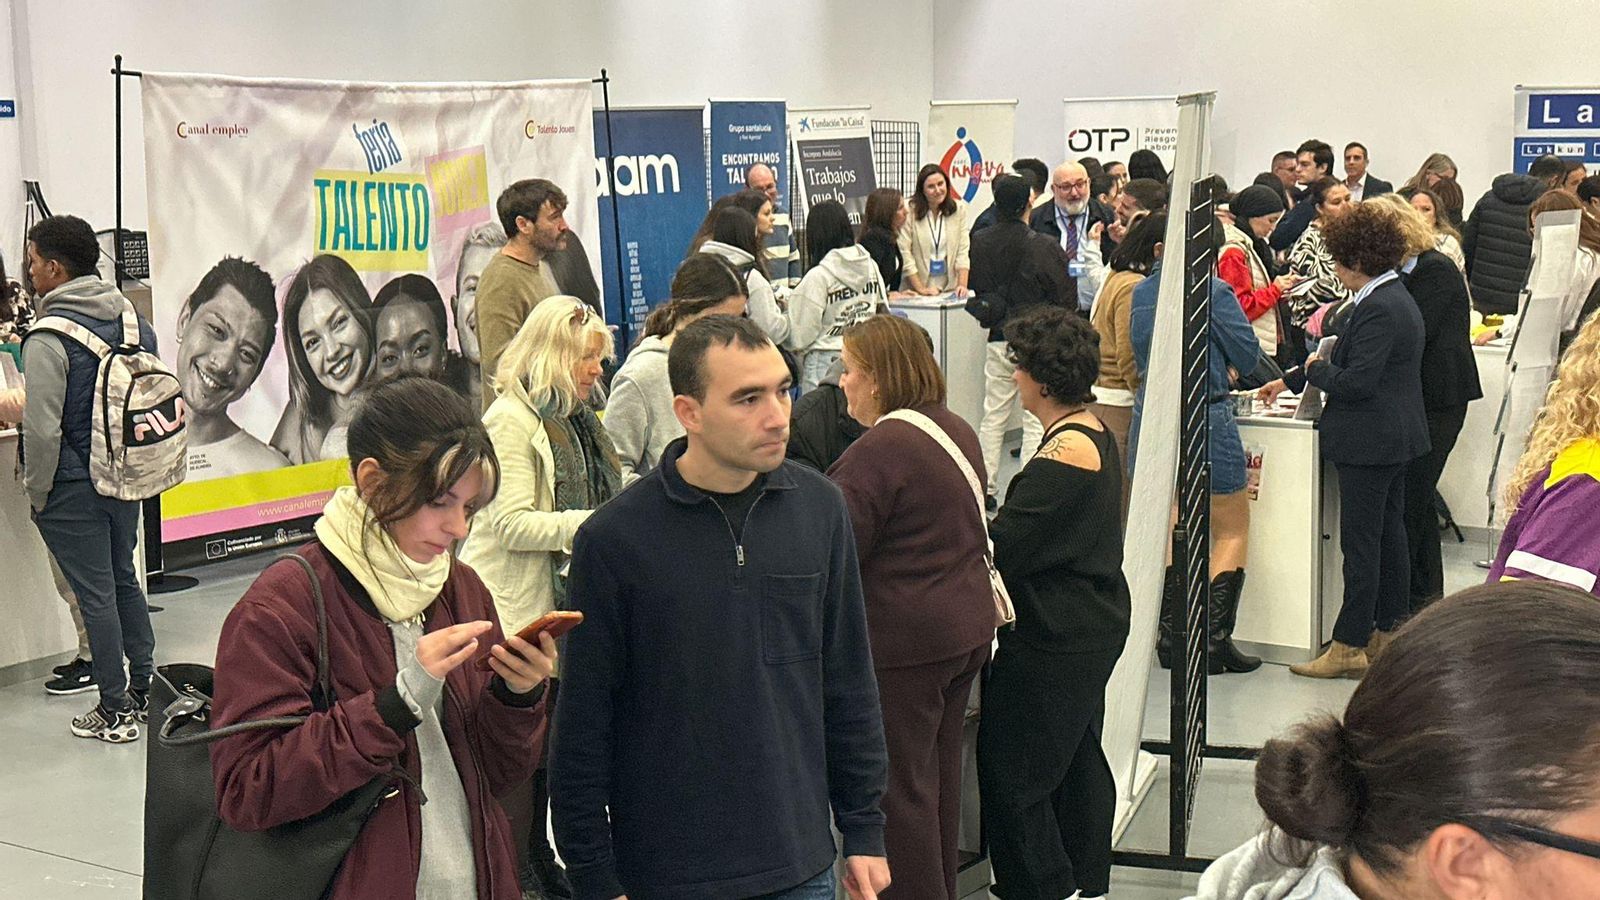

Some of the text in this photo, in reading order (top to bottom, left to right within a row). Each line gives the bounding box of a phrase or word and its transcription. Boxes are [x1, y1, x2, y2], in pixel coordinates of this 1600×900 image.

[177, 121, 248, 138] Canal empleo
[537, 125, 557, 134] Talento
[729, 124, 744, 134] Grupo
[811, 118, 840, 128] Fundación
[353, 118, 402, 175] feria
[1068, 128, 1130, 152] OTP
[722, 152, 780, 165] ENCONTRAMOS
[806, 166, 856, 188] Trabajos
[833, 187, 845, 205] lo
[314, 179, 429, 251] TALENTO
[132, 396, 185, 441] FILA
